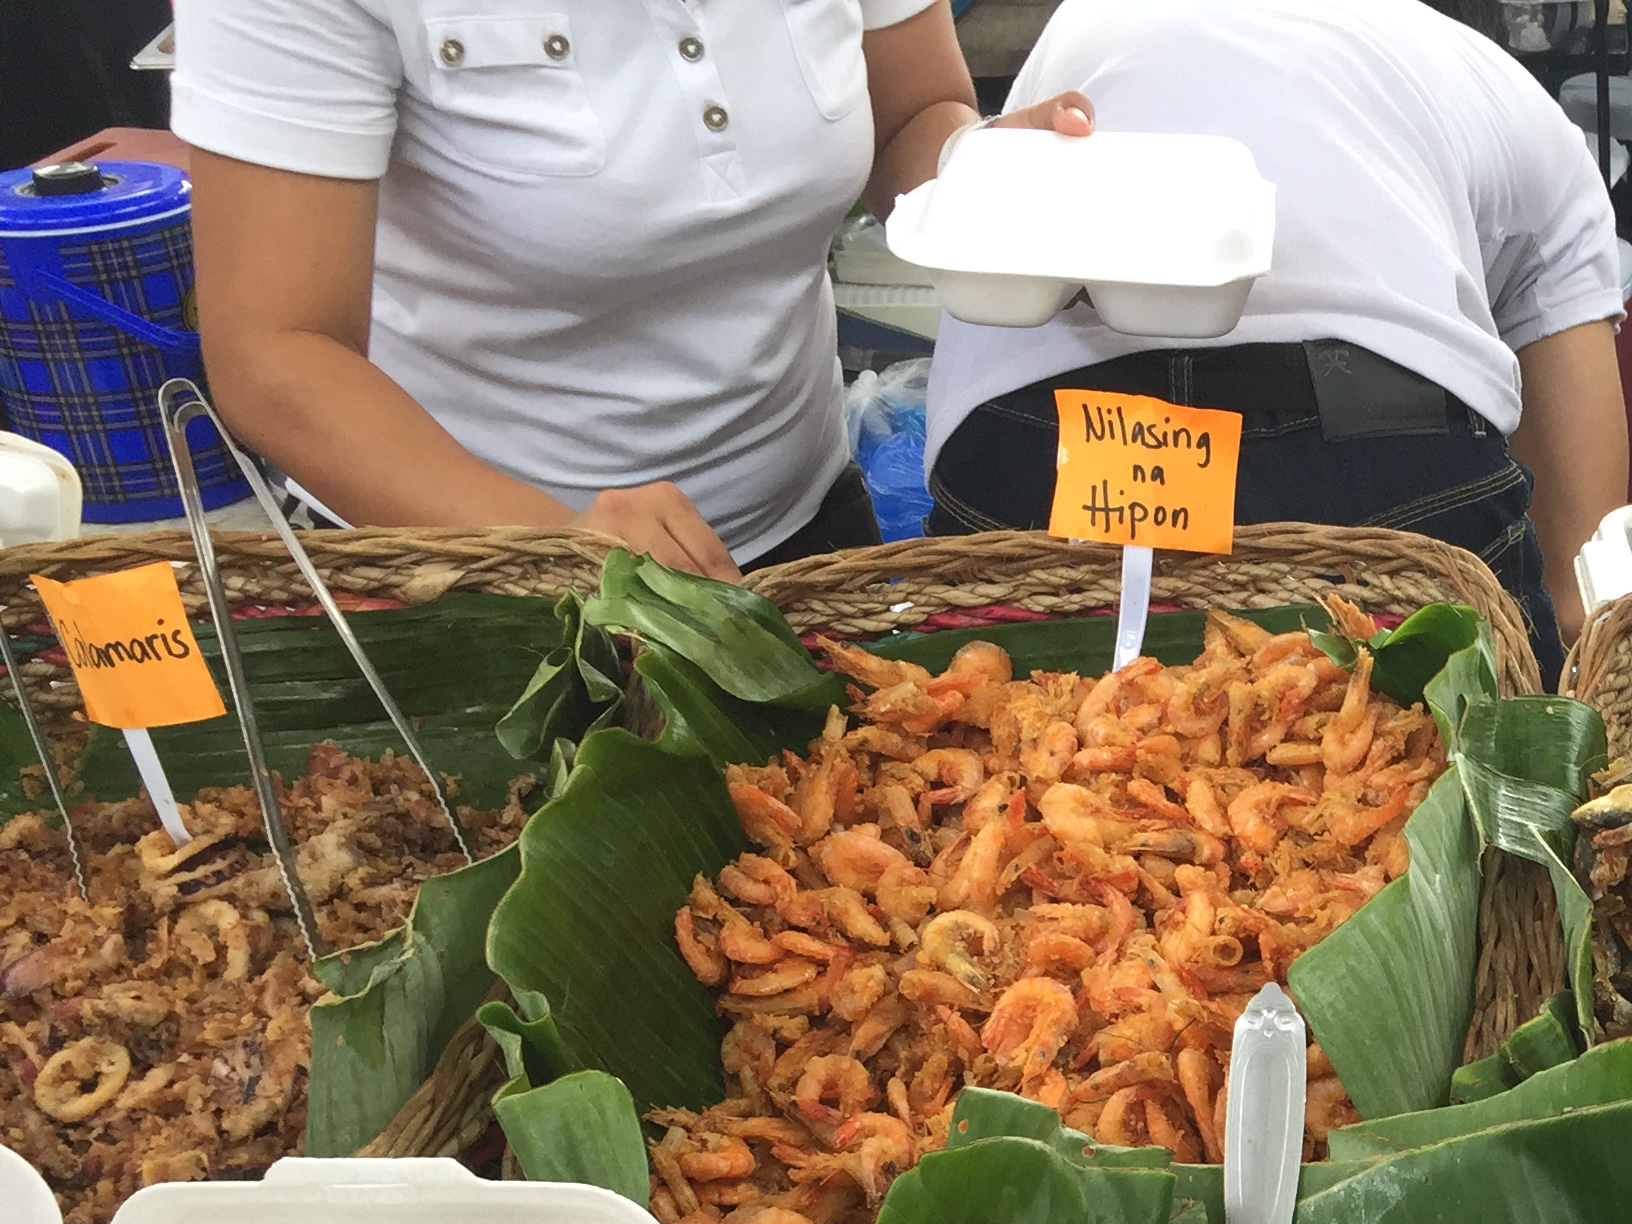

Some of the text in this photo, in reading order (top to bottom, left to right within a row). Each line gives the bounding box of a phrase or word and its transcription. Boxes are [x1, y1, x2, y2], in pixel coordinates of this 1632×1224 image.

[1081, 402, 1212, 469] Nilasing
[1132, 463, 1166, 486] na
[1081, 478, 1189, 540] Hipon
[58, 617, 190, 670] Calamaris
